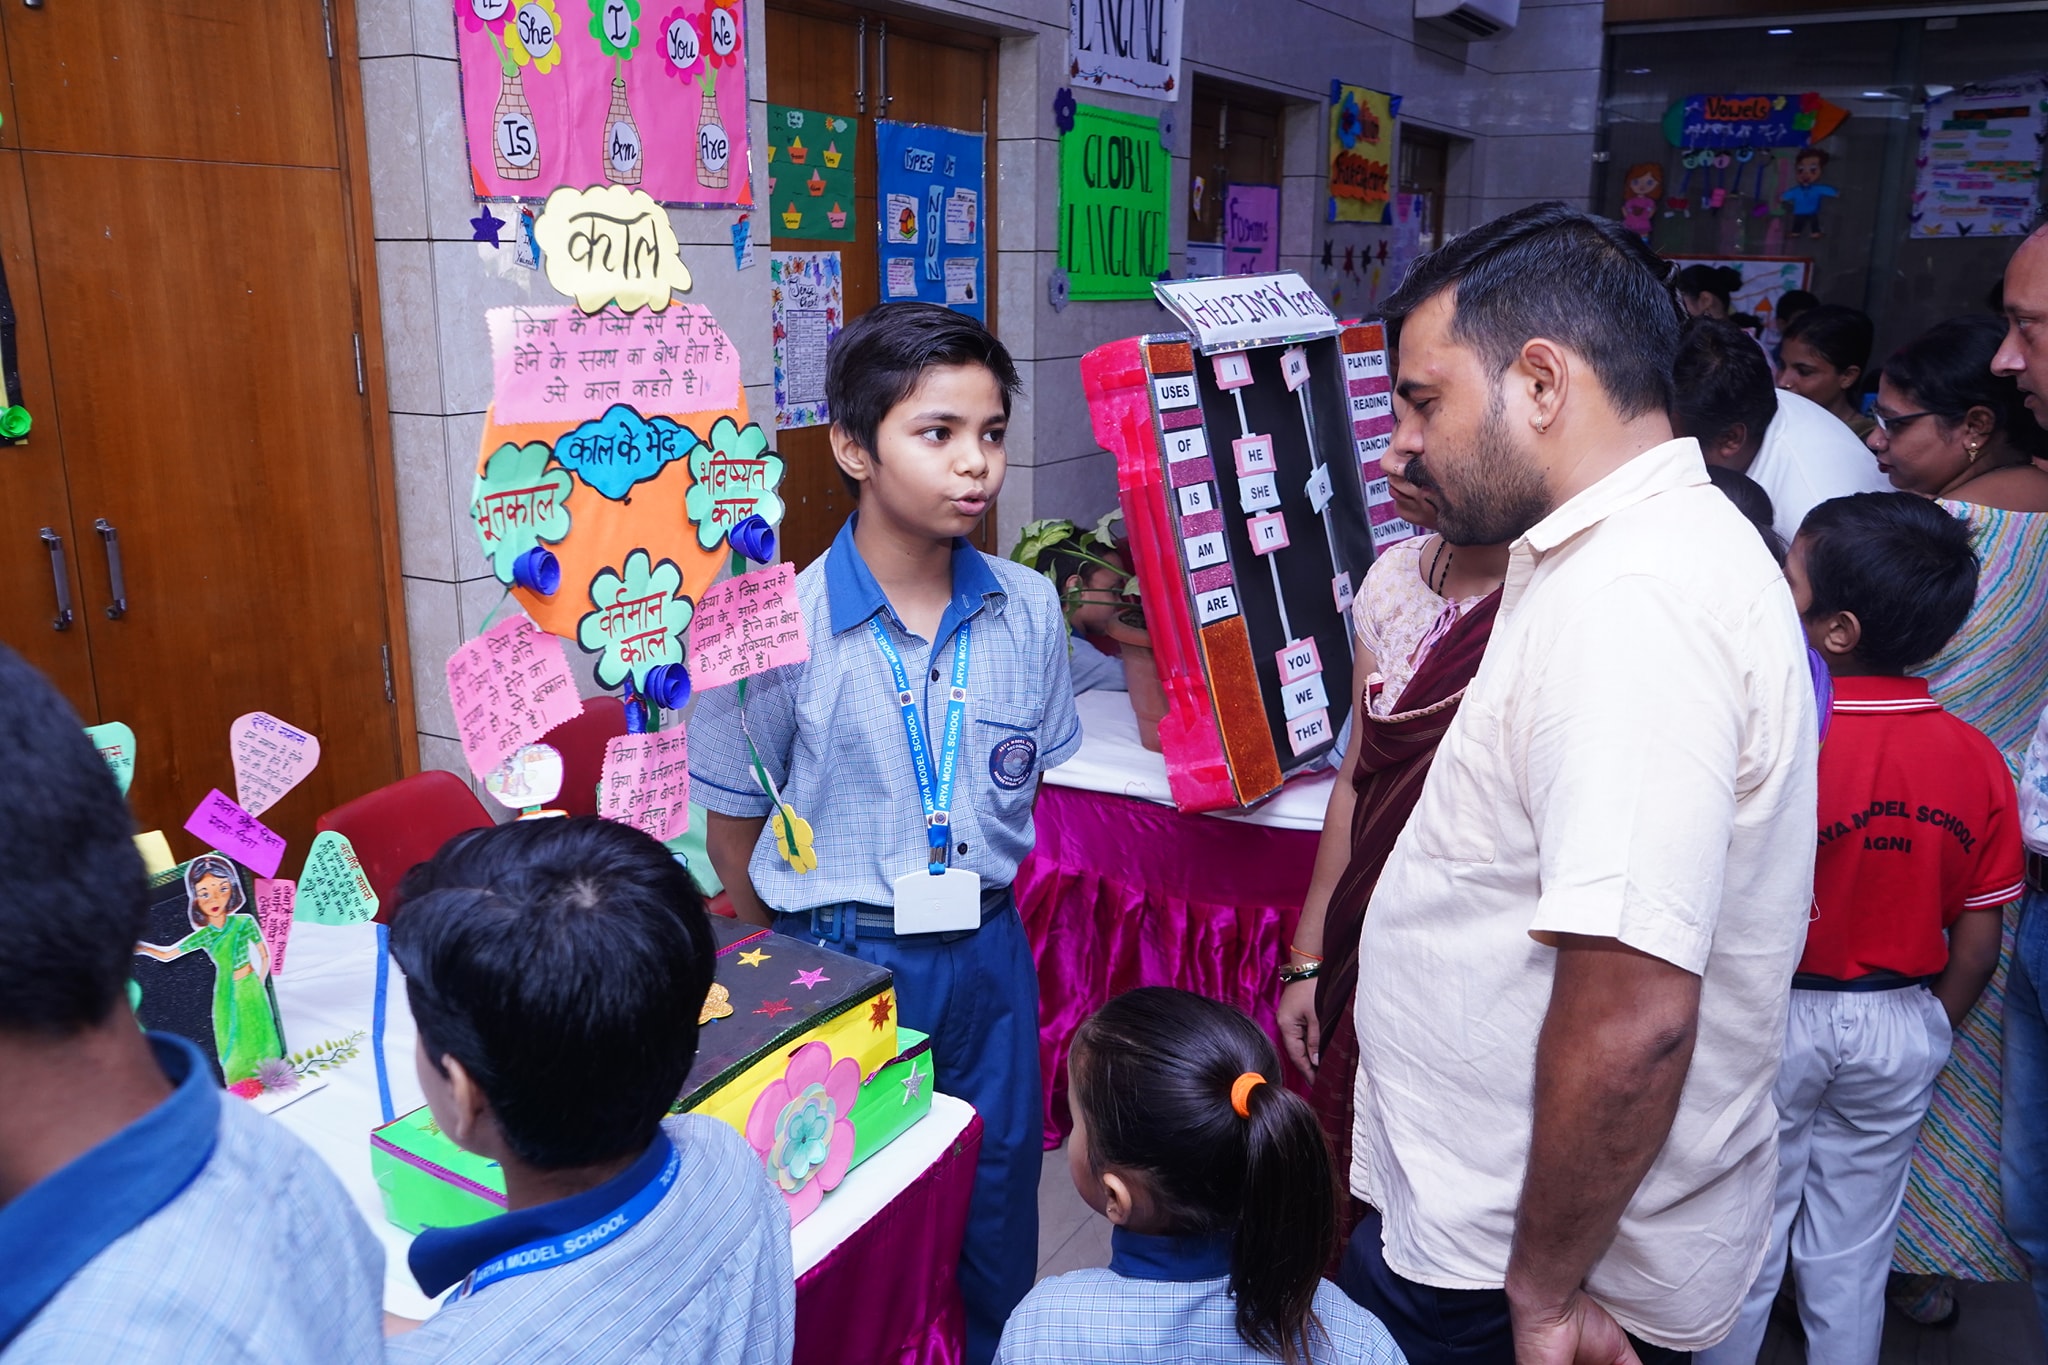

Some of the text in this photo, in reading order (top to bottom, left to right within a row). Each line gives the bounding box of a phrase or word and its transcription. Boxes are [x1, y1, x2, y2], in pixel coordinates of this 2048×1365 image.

[518, 11, 552, 45] She
[607, 6, 627, 41] I
[712, 11, 731, 46] We
[669, 27, 695, 60] You
[1707, 97, 1768, 119] Vowels
[611, 130, 637, 162] Am
[701, 132, 727, 160] Are
[1083, 133, 1154, 194] GLOBAL
[568, 212, 660, 280] काल
[928, 191, 941, 280] NOUN
[1067, 203, 1162, 278] LANGUAGE
[567, 309, 588, 335] के
[599, 308, 634, 337] जिस
[676, 306, 694, 336] से
[514, 342, 542, 375] होने
[550, 342, 568, 372] के
[578, 349, 619, 372] समय
[627, 348, 646, 366] का
[653, 340, 680, 365] बोध
[684, 337, 710, 364] होता
[1233, 364, 1238, 376] I
[1290, 362, 1301, 376] AM
[1347, 354, 1383, 370] PLAYING
[543, 376, 569, 404] उसे
[584, 380, 620, 401] काल
[632, 368, 673, 398] कहते
[1161, 384, 1190, 399] USES
[1354, 396, 1389, 412] READING
[569, 421, 681, 466] काल के भेद
[1178, 439, 1192, 453] OF
[1248, 448, 1263, 462] HE
[1360, 437, 1390, 452] DANCIN
[1190, 492, 1200, 505] IS
[1250, 485, 1270, 500] SHE
[1318, 481, 1326, 495] IS
[477, 483, 559, 541] भूतकाल
[711, 498, 758, 527] काल
[1264, 527, 1274, 540] IT
[1373, 520, 1411, 540] RUNNING
[1198, 543, 1214, 558] AM
[696, 594, 720, 613] क्रिया
[724, 586, 735, 605] के
[739, 580, 760, 600] जिस
[778, 571, 788, 586] से
[1207, 595, 1229, 613] ARE
[1338, 584, 1349, 599] ARE
[599, 588, 668, 640] वर्तमान
[694, 592, 784, 633] क्रिया के आने वाले
[695, 609, 799, 652] समय में होने का बोध
[959, 627, 969, 661] MODEL
[621, 626, 668, 667] काल
[718, 645, 733, 666] उसे
[776, 630, 799, 644] काल
[877, 633, 899, 663] MODEL
[528, 658, 547, 679] का
[729, 655, 751, 677] कहते
[955, 660, 966, 686] ARYA
[1288, 652, 1311, 671] YOU
[895, 663, 907, 689] ARYA
[1295, 689, 1313, 705] WE
[1295, 720, 1324, 742] THEY
[611, 741, 638, 765] क्रिया
[642, 740, 653, 759] के
[905, 710, 935, 811] ARYA MODEL SCHOOL
[938, 707, 960, 809] ARYA MODEL SCHOOL
[1916, 806, 1977, 855] SCHOOL
[1863, 837, 1912, 854] AGNI
[475, 1213, 629, 1283] ARYA MODEL SCHOOL
